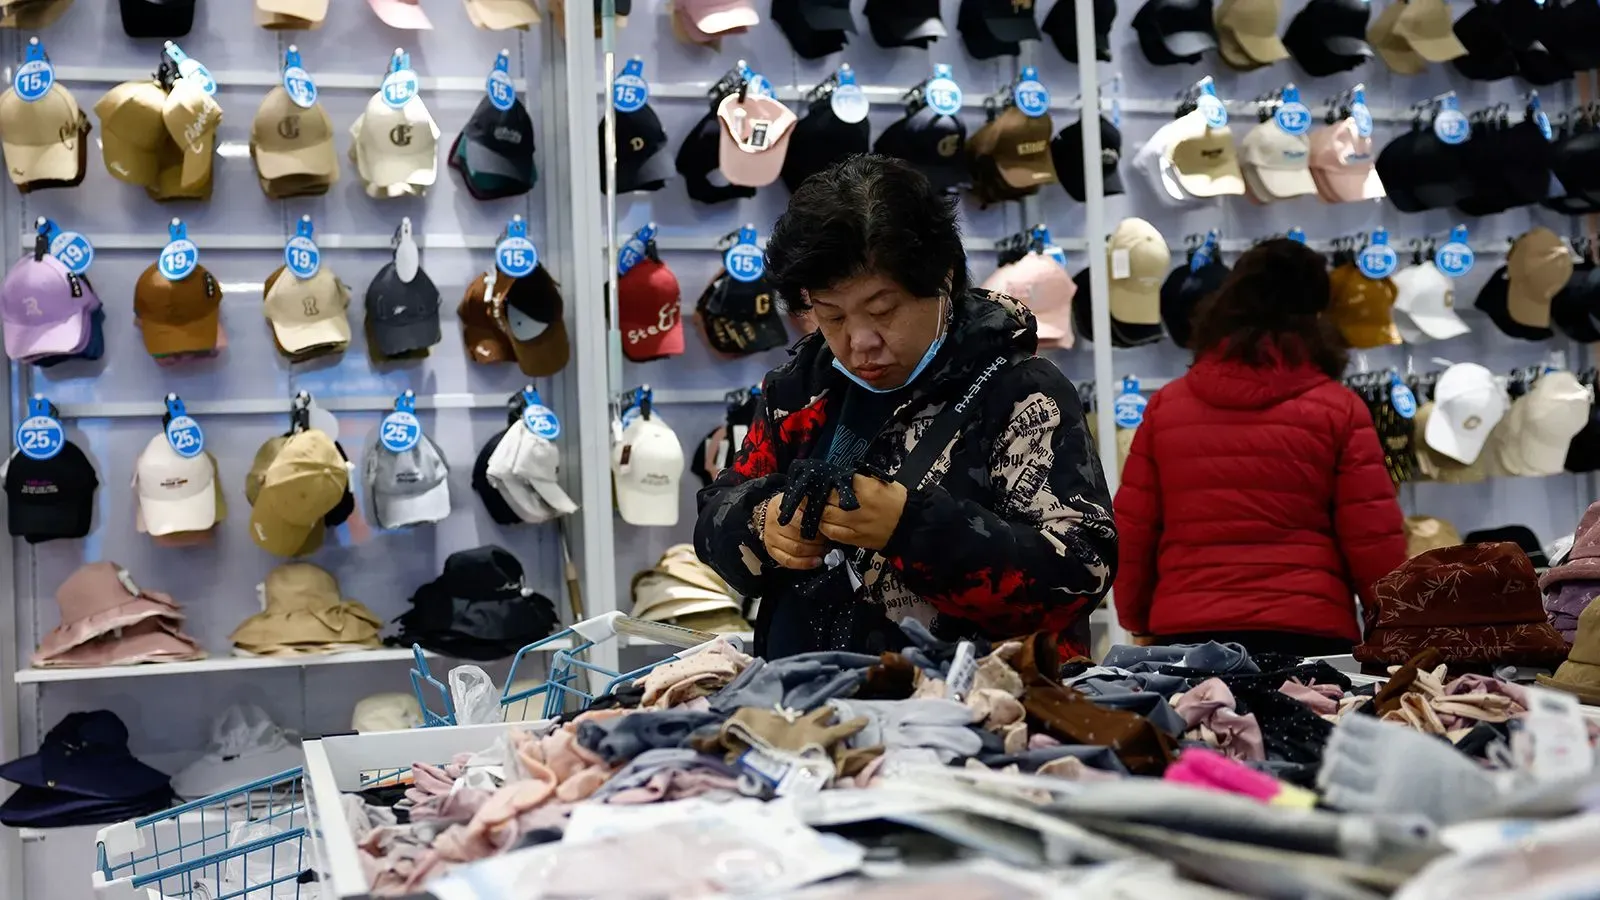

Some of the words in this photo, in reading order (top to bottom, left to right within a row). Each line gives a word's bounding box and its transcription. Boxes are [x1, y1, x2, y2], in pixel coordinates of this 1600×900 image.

[21, 74, 42, 92] 15
[287, 79, 308, 98] 15
[385, 84, 408, 101] 15
[492, 83, 509, 101] 15
[615, 86, 637, 102] 15
[1021, 92, 1040, 106] 15
[1282, 112, 1301, 127] 12
[59, 244, 84, 268] 19
[165, 254, 187, 271] 19
[290, 250, 311, 268] 19
[503, 250, 525, 267] 15
[733, 256, 754, 272] 15
[1366, 255, 1386, 269] 15
[530, 415, 552, 431] 25
[24, 430, 50, 449] 25
[173, 429, 195, 449] 25
[384, 424, 408, 443] 25
